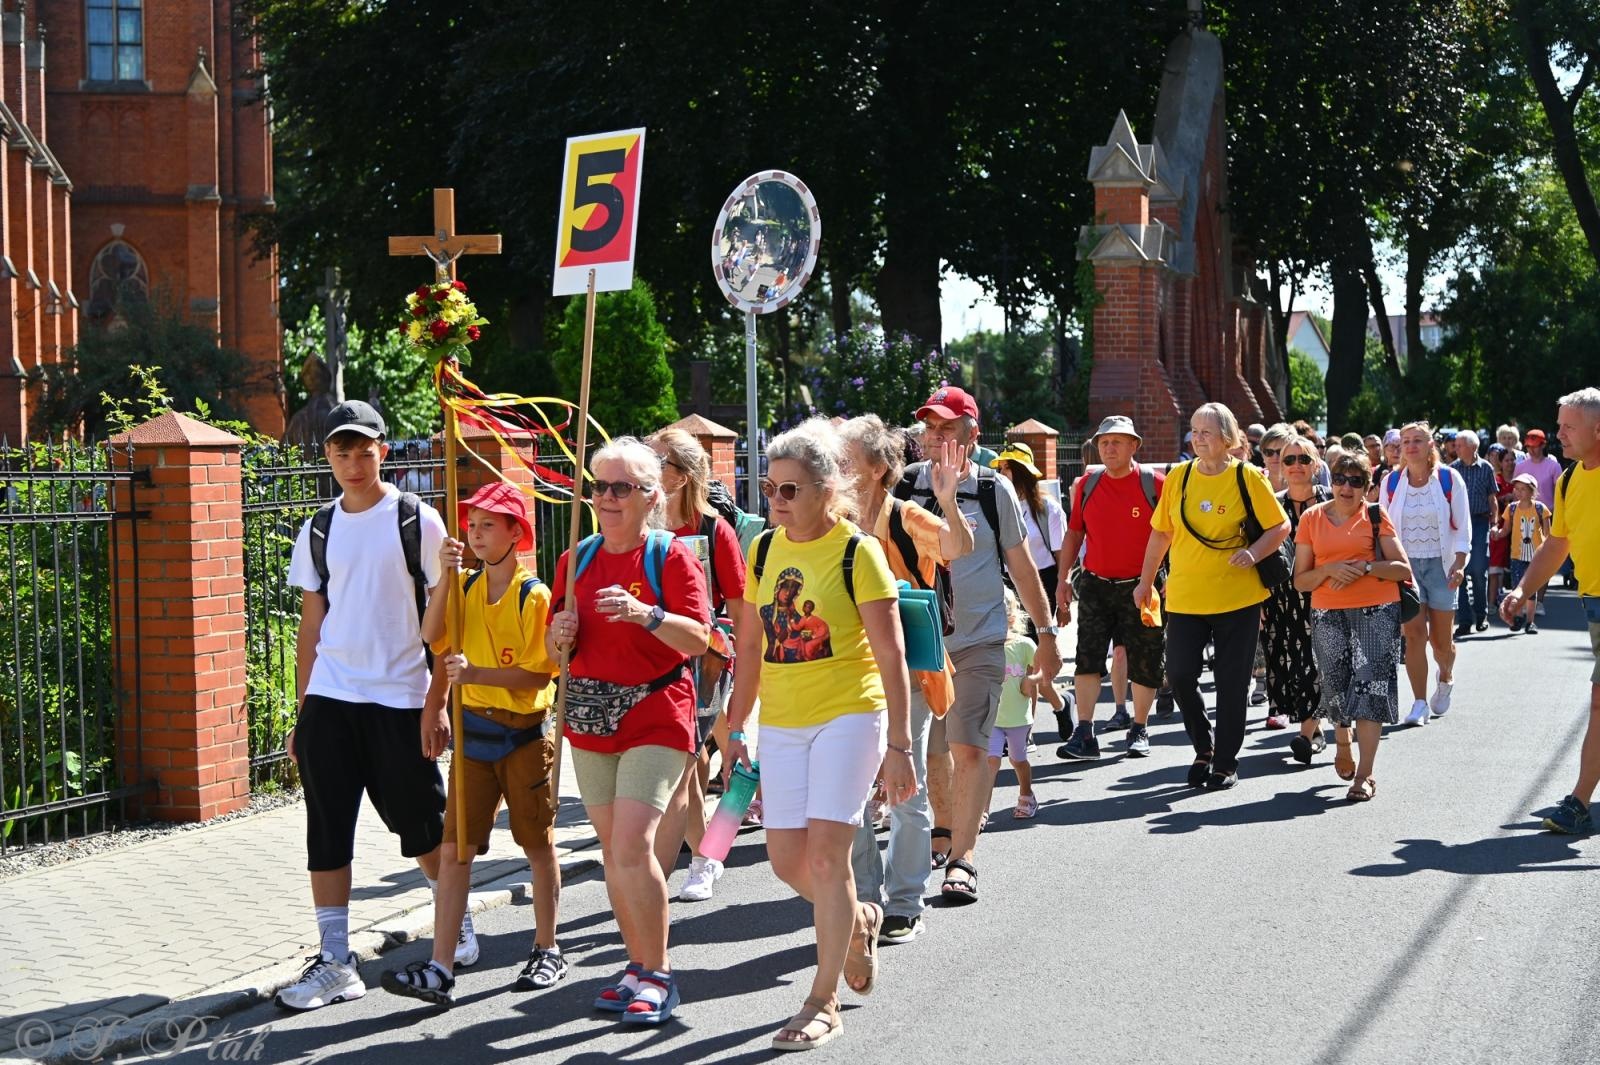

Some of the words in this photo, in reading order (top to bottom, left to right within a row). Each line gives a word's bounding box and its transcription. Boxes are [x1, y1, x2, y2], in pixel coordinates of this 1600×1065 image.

[570, 148, 626, 252] 5
[1132, 507, 1140, 518] 5
[1218, 505, 1226, 515] 5
[629, 582, 643, 598] 5
[501, 648, 513, 665] 5
